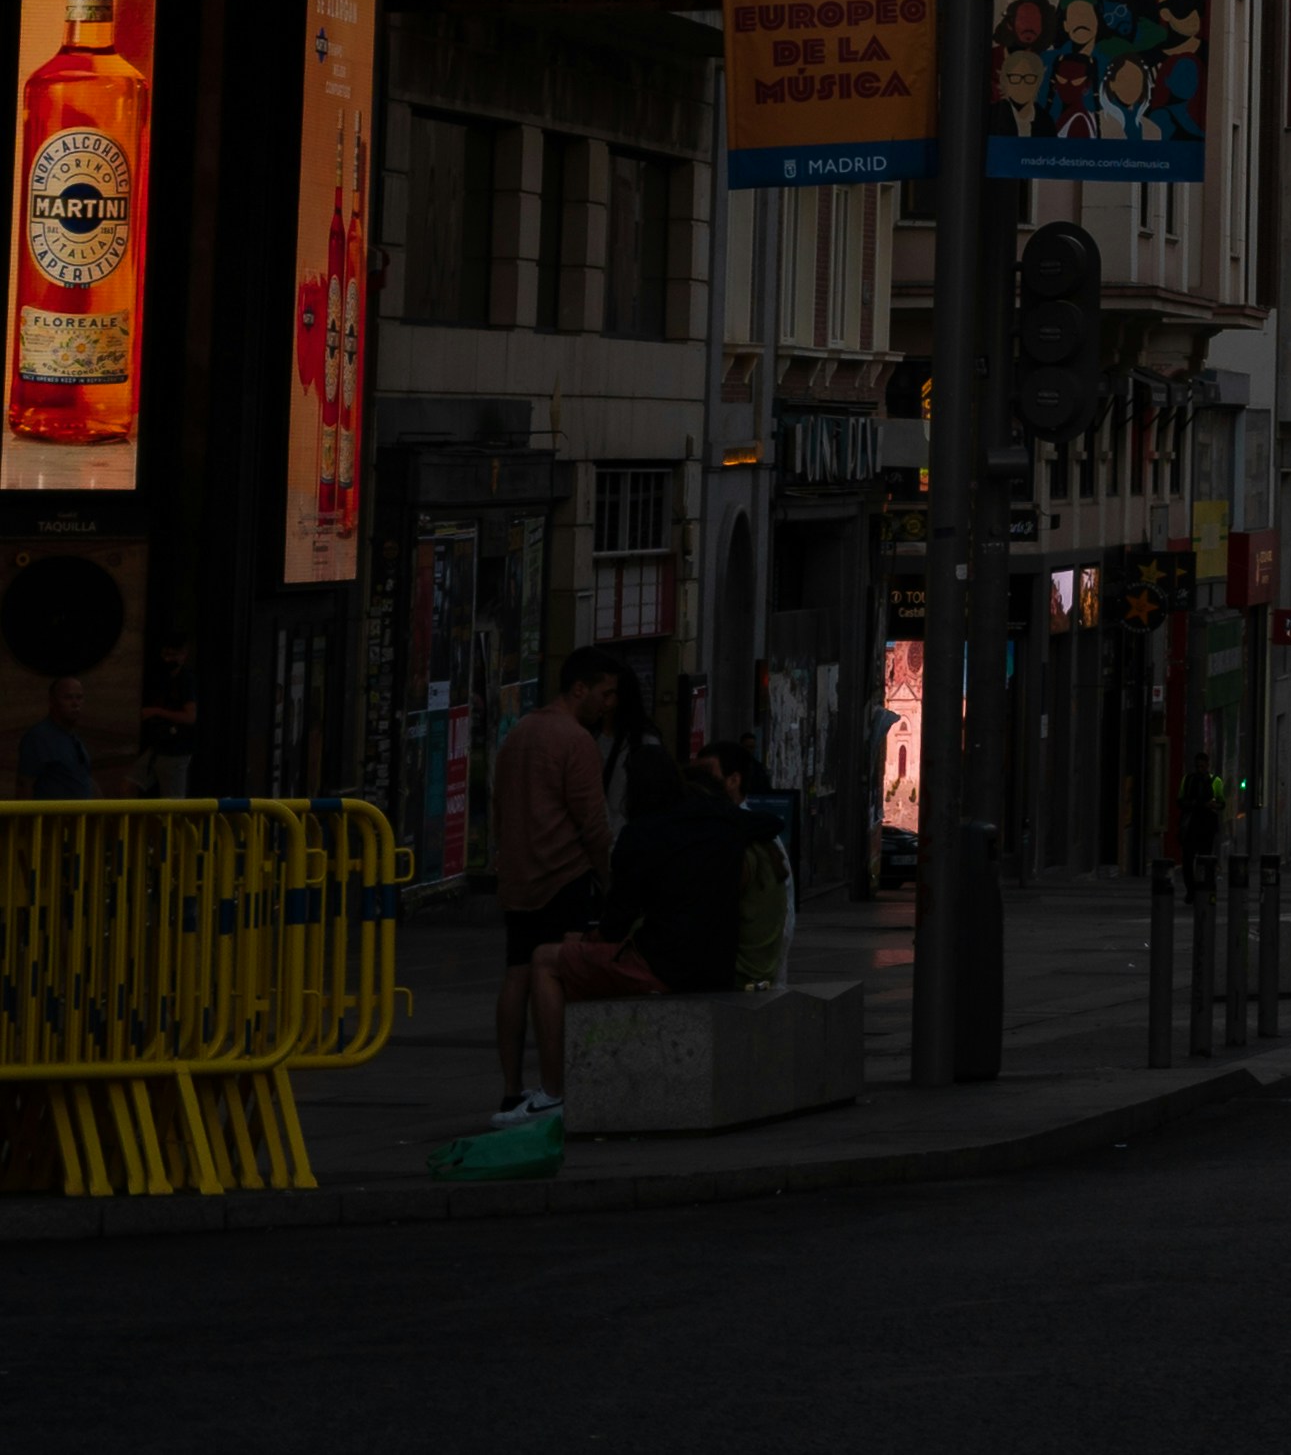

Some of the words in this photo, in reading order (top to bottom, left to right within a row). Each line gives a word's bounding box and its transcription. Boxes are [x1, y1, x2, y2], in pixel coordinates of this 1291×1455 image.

[772, 38, 826, 67] DE
[838, 34, 892, 62] LA
[755, 67, 912, 105] MÚSICA
[34, 136, 129, 185] NON-ALCOHOLIC
[52, 158, 112, 184] TORINO
[808, 155, 888, 175] MADRID
[35, 197, 126, 219] MARTINI
[52, 237, 107, 259] ITALIA
[34, 316, 118, 327] FLOREALE
[37, 521, 97, 532] TAQUILLA
